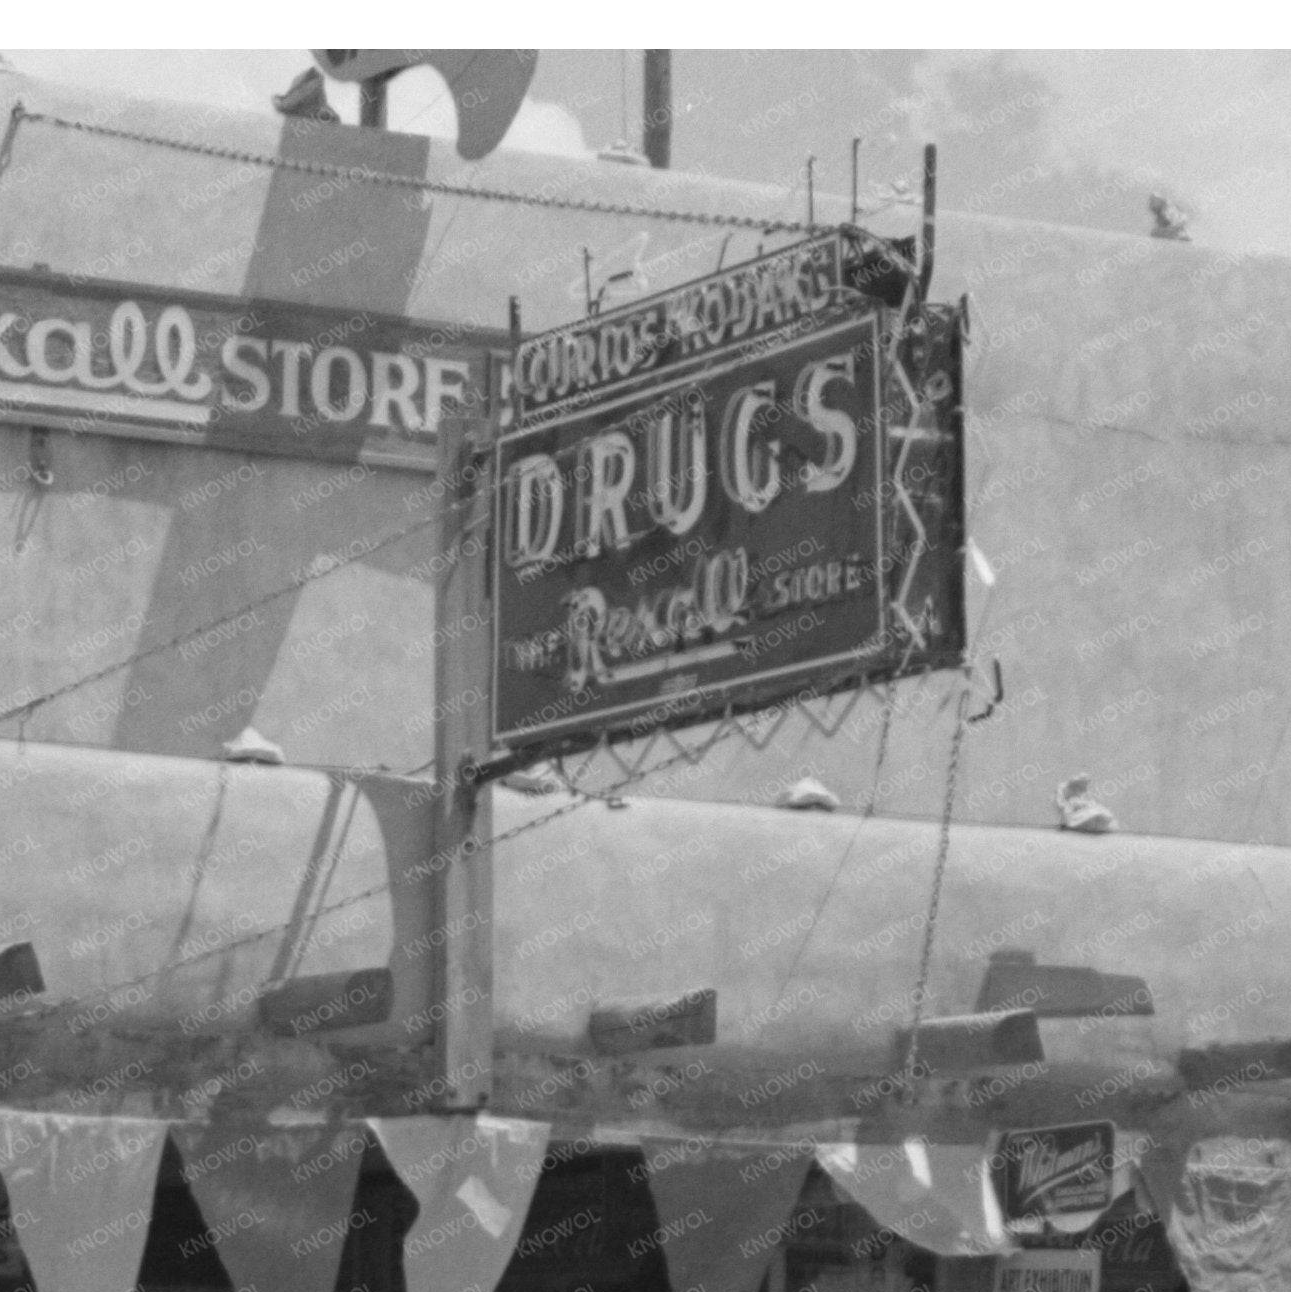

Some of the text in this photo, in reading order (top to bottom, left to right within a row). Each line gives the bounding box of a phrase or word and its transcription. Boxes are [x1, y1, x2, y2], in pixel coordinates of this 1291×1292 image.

[504, 352, 858, 574] DRUGS
[563, 547, 751, 692] Rexall
[771, 554, 861, 606] STORE
